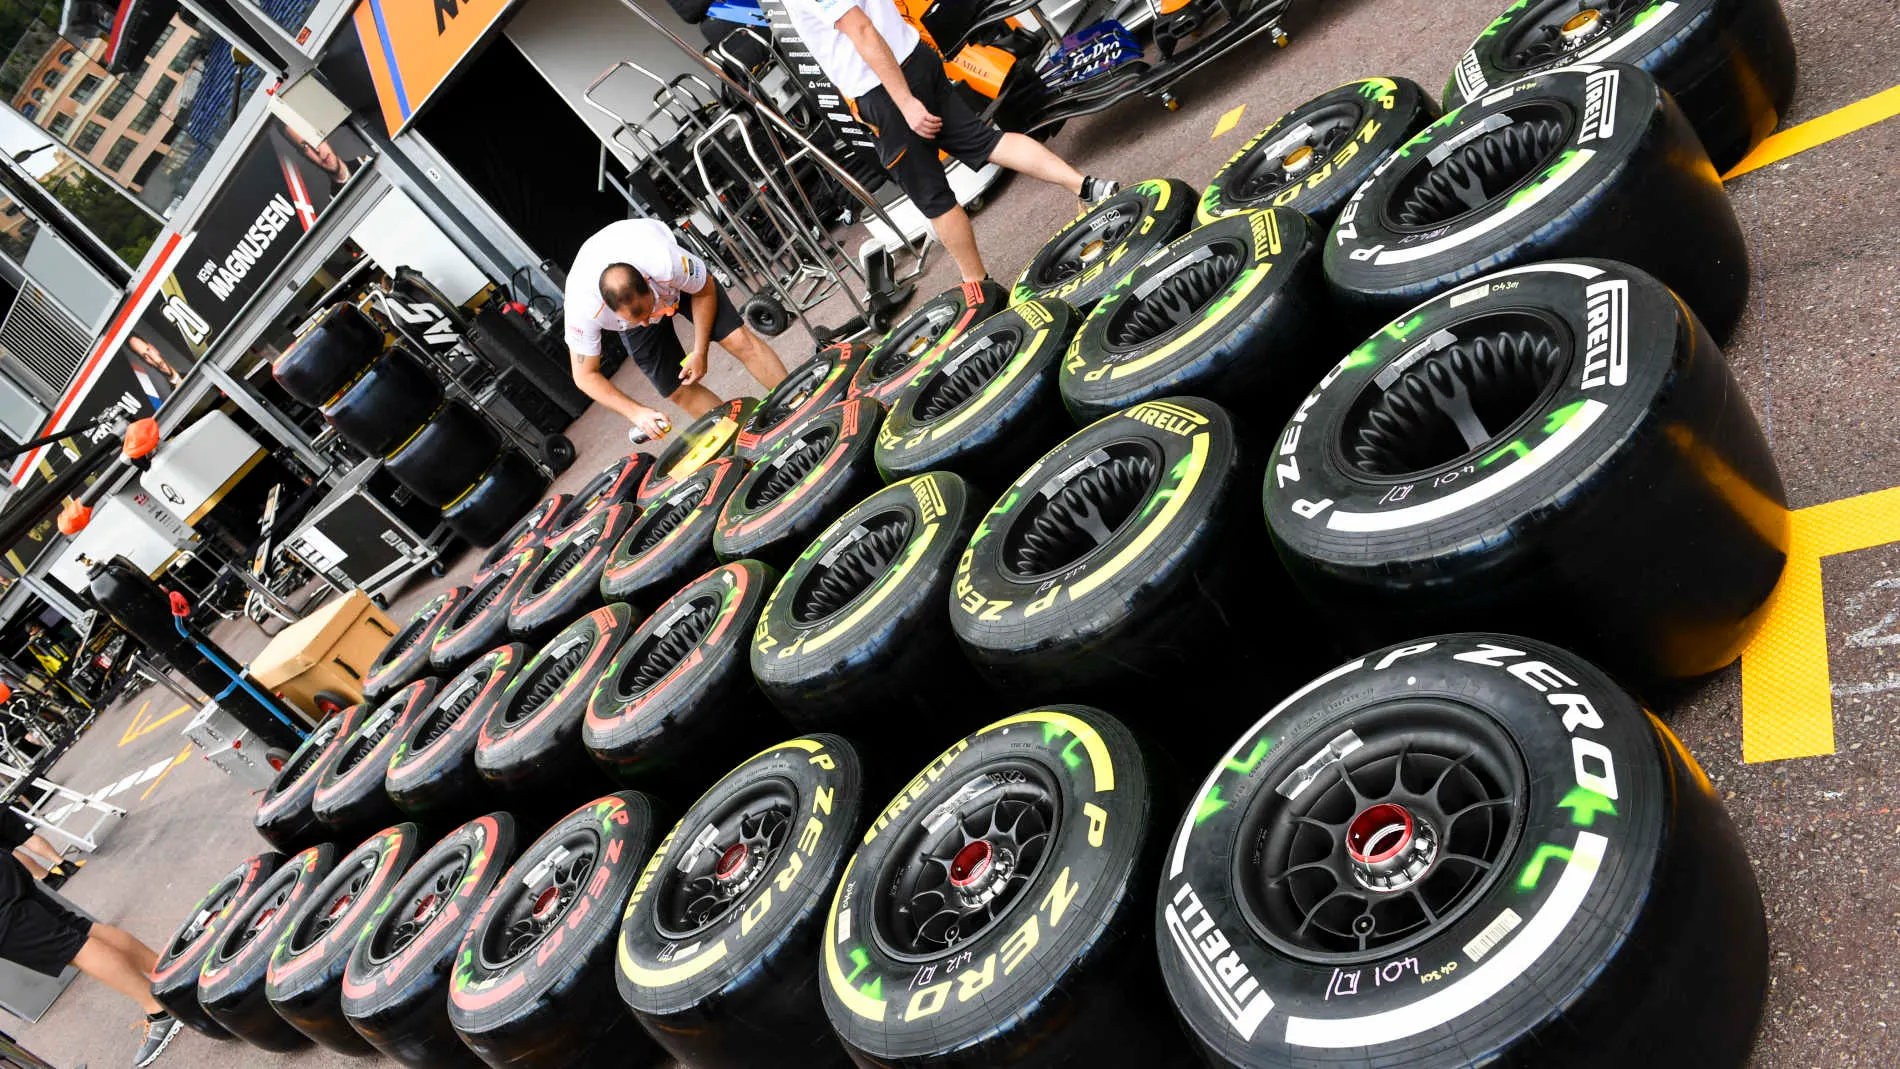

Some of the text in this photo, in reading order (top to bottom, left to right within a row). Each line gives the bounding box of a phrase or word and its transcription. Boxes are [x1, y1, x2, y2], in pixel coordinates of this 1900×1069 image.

[1577, 69, 1620, 145] PIRELLI
[1273, 119, 1381, 206] ZERO
[1336, 150, 1401, 261] P ZERO
[196, 259, 218, 284] KEVIN
[207, 193, 295, 302] MAGNUSSEN
[1249, 209, 1282, 261] PIRELLI
[162, 295, 210, 345] 20
[1580, 279, 1628, 390] PIRELLI
[1124, 401, 1210, 436] PIRELLI
[1276, 355, 1351, 519] P ZERO
[910, 474, 947, 524] PIRELLI
[956, 548, 1062, 621] P ZERO
[808, 753, 836, 770] P
[1373, 642, 1619, 800] P ZERO
[864, 738, 969, 845] PIRELLI
[537, 810, 629, 967] P ZERO
[741, 785, 835, 936] ZERO
[904, 802, 1107, 1022] P ZERO
[1164, 882, 1275, 1042] PIRELLI
[1376, 957, 1421, 987] 401
[1420, 961, 1457, 984] 04301
